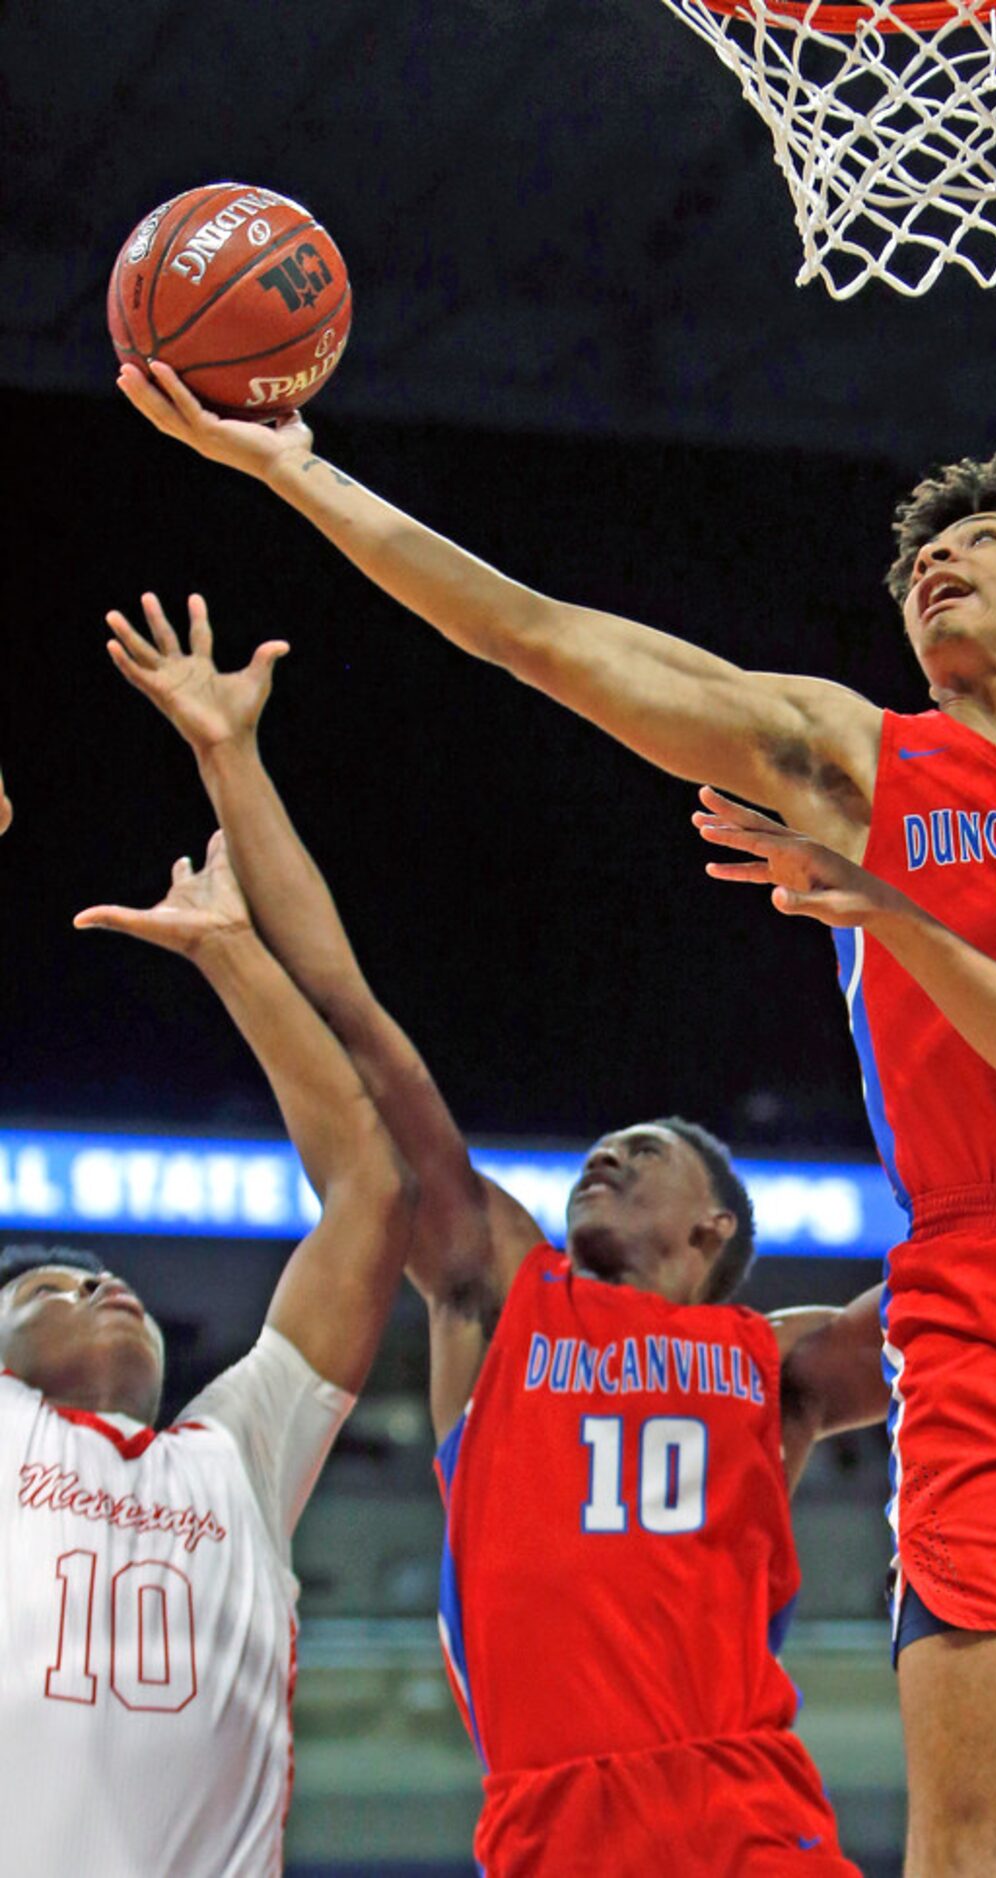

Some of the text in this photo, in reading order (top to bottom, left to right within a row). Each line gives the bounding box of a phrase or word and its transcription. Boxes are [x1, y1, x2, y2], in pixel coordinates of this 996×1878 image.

[71, 1147, 288, 1226] STATE
[524, 1331, 765, 1406] DUNCANVILLE
[580, 1414, 708, 1534] 10
[44, 1548, 198, 1714] 10
